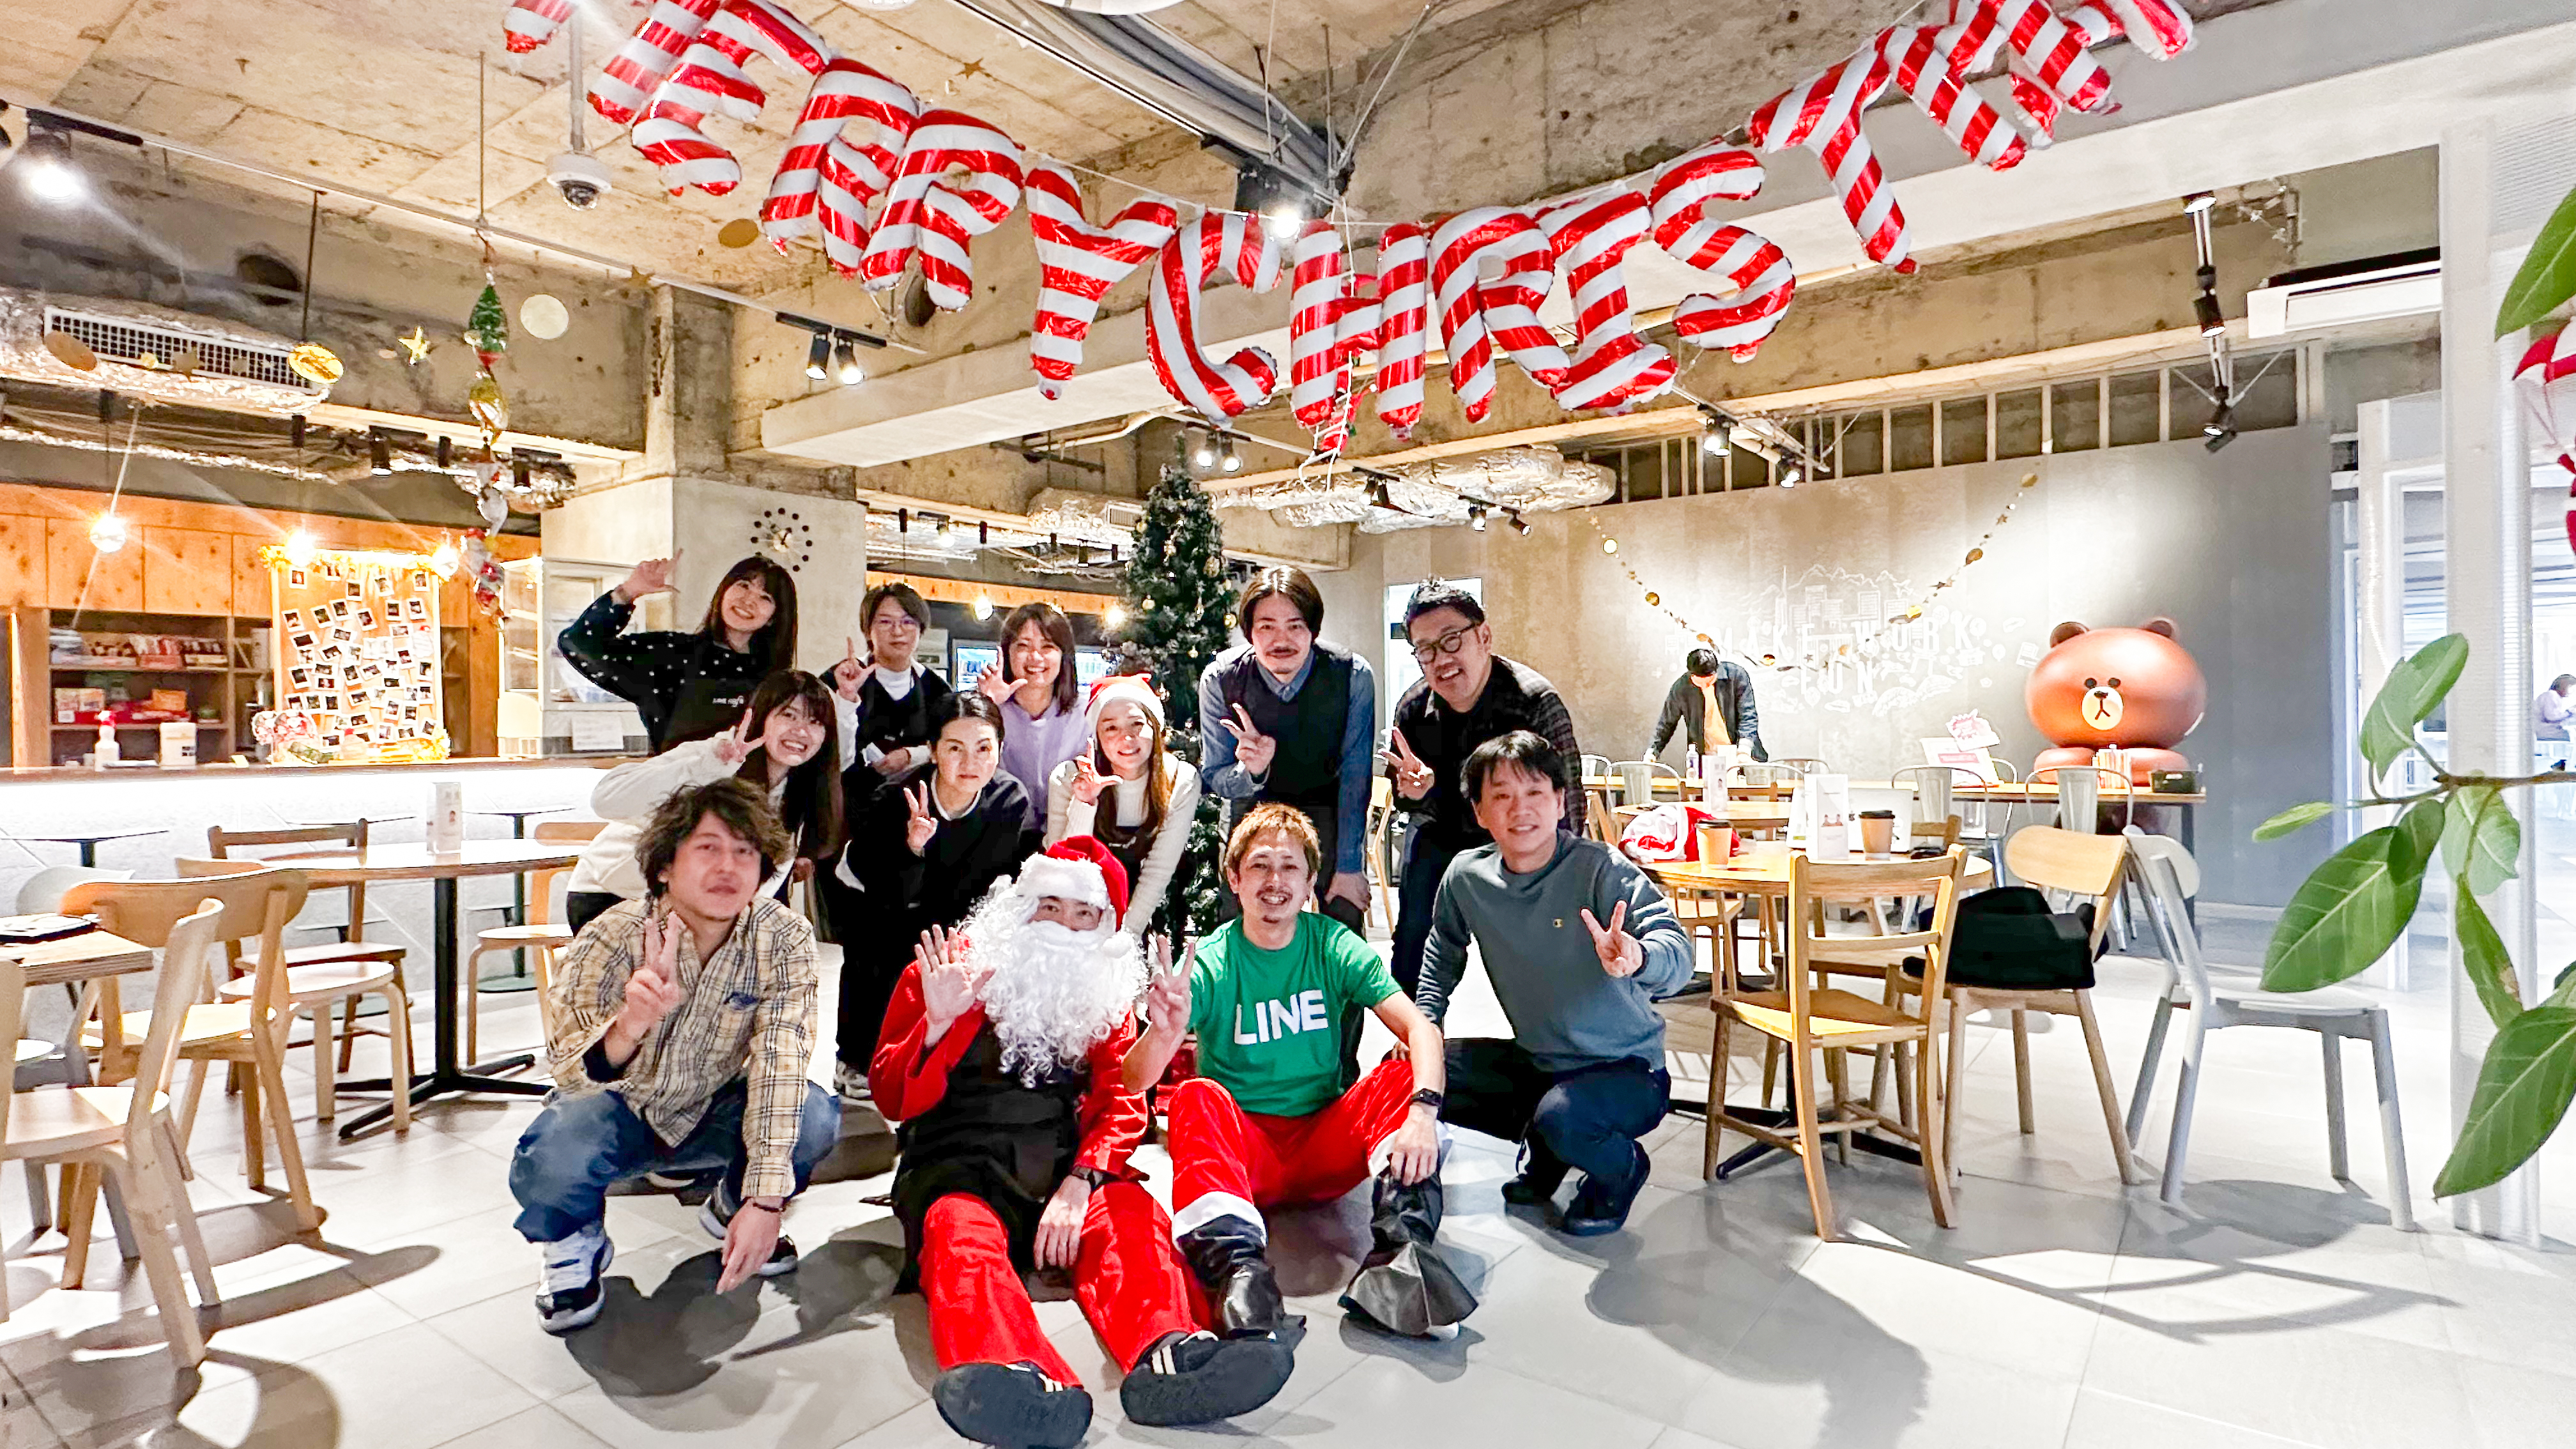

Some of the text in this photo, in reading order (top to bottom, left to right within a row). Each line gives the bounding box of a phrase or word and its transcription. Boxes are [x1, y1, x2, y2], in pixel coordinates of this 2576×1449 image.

[1710, 615, 1975, 659] MAKE WORK
[1800, 660, 1873, 695] FUN
[1234, 989, 1329, 1045] LINE
